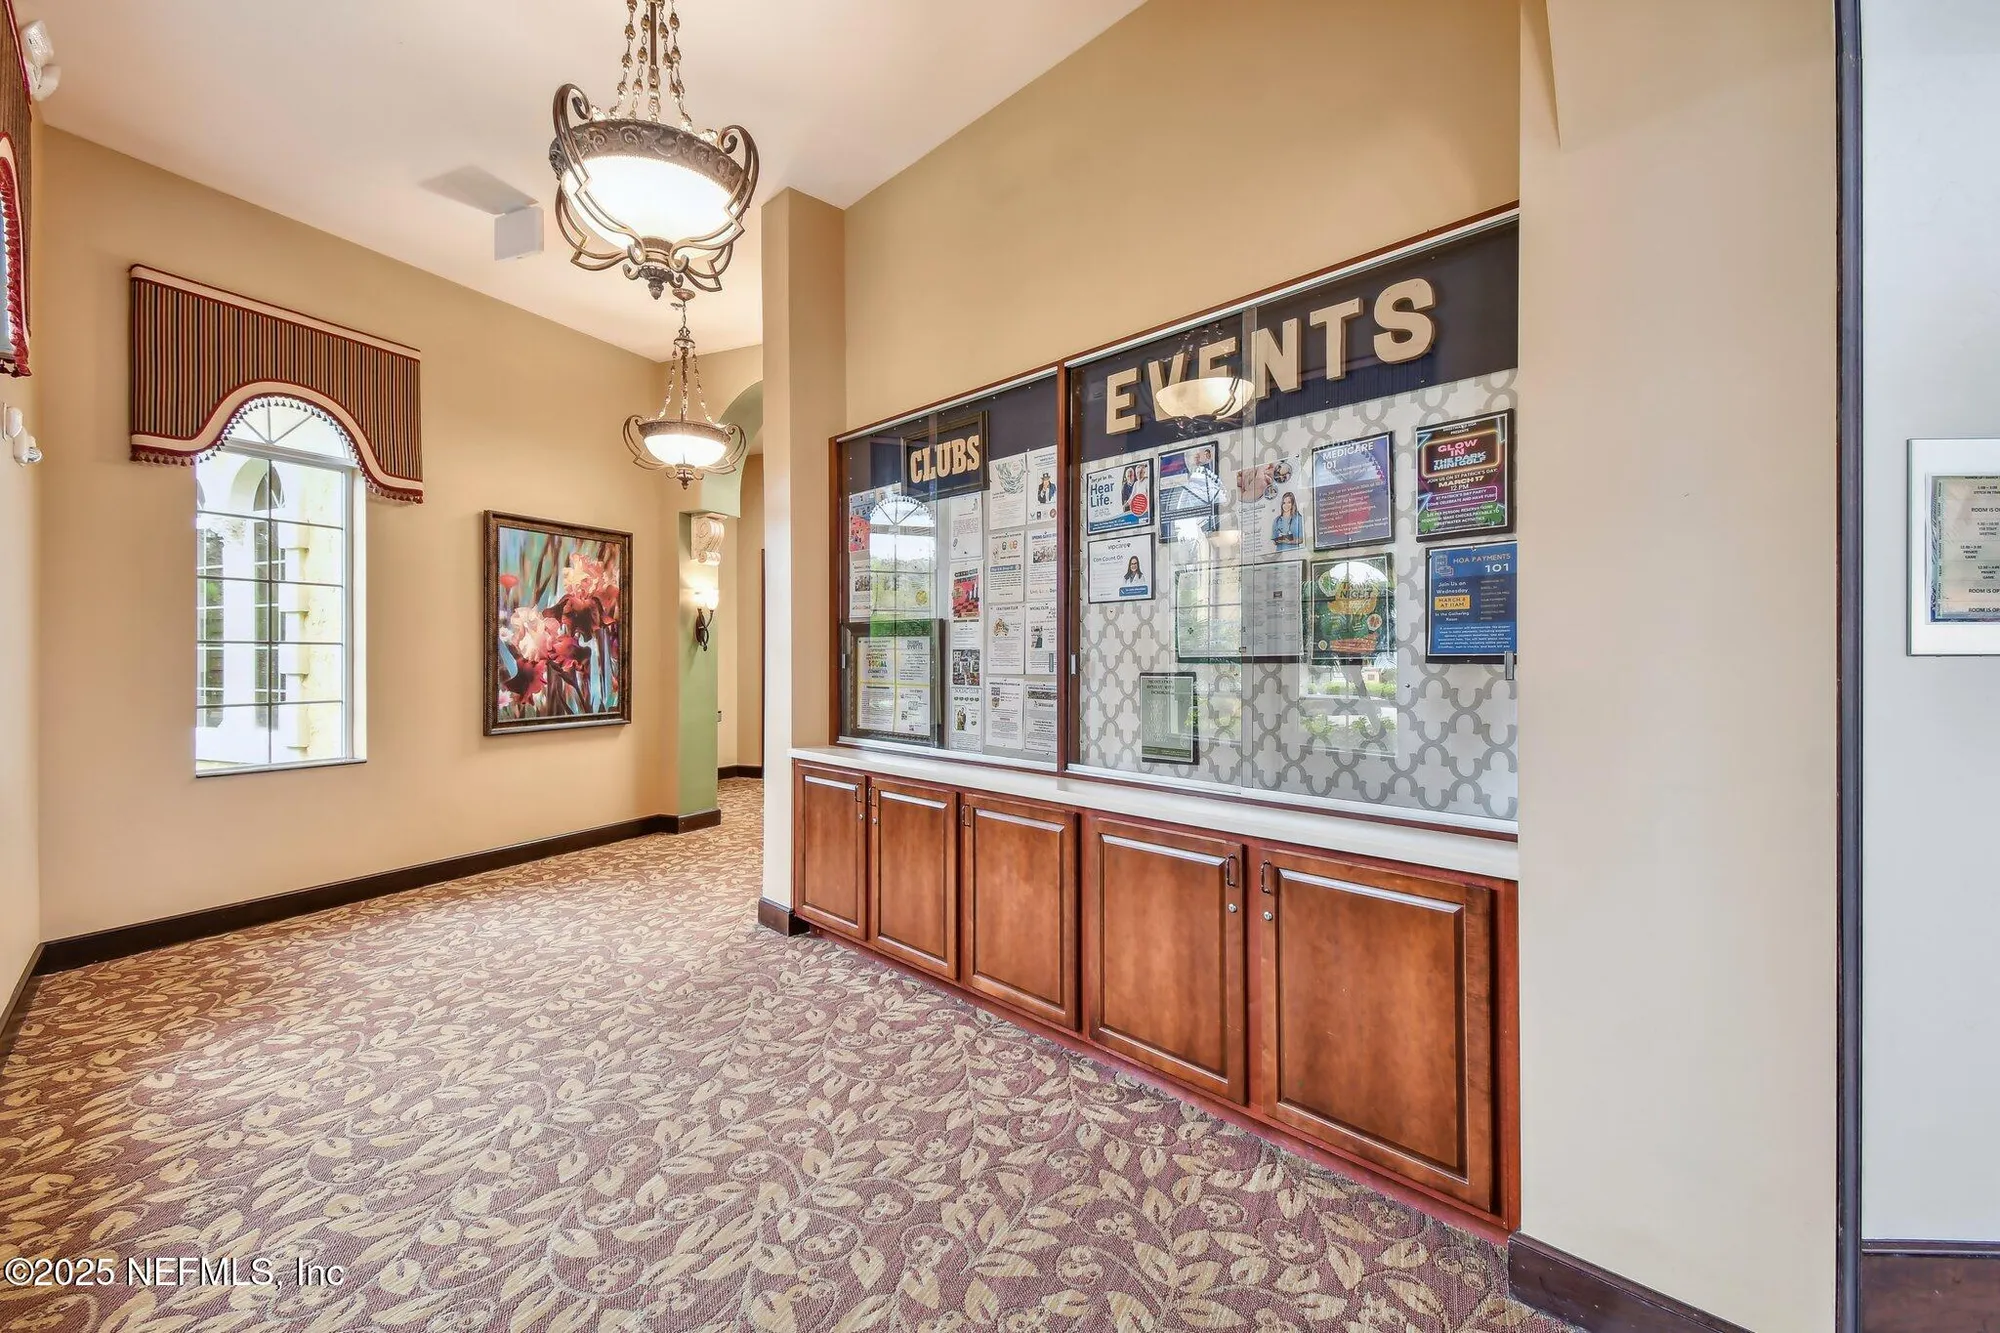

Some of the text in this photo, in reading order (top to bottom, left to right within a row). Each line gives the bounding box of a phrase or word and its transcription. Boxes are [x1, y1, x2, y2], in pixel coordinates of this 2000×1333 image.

[1106, 277, 1436, 436] EVENTS
[1322, 442, 1374, 460] MEDICARE
[1438, 439, 1479, 453] GLOW
[1433, 450, 1486, 466] THE DARK
[1450, 448, 1465, 457] IN
[910, 435, 980, 484] CLUBS
[1322, 459, 1337, 470] 101
[1433, 456, 1487, 471] MINI GOLF
[1460, 470, 1486, 479] PATRICK'S
[1438, 477, 1474, 487] MARCH
[1090, 482, 1115, 495] Hear
[1090, 494, 1113, 508] Life.
[1441, 492, 1462, 500] PATRICK'S
[1439, 498, 1462, 506] CELEBRATE
[1453, 553, 1511, 564] HOA PAYMENTS
[1485, 563, 1509, 573] 101
[1340, 590, 1373, 599] NIGHT
